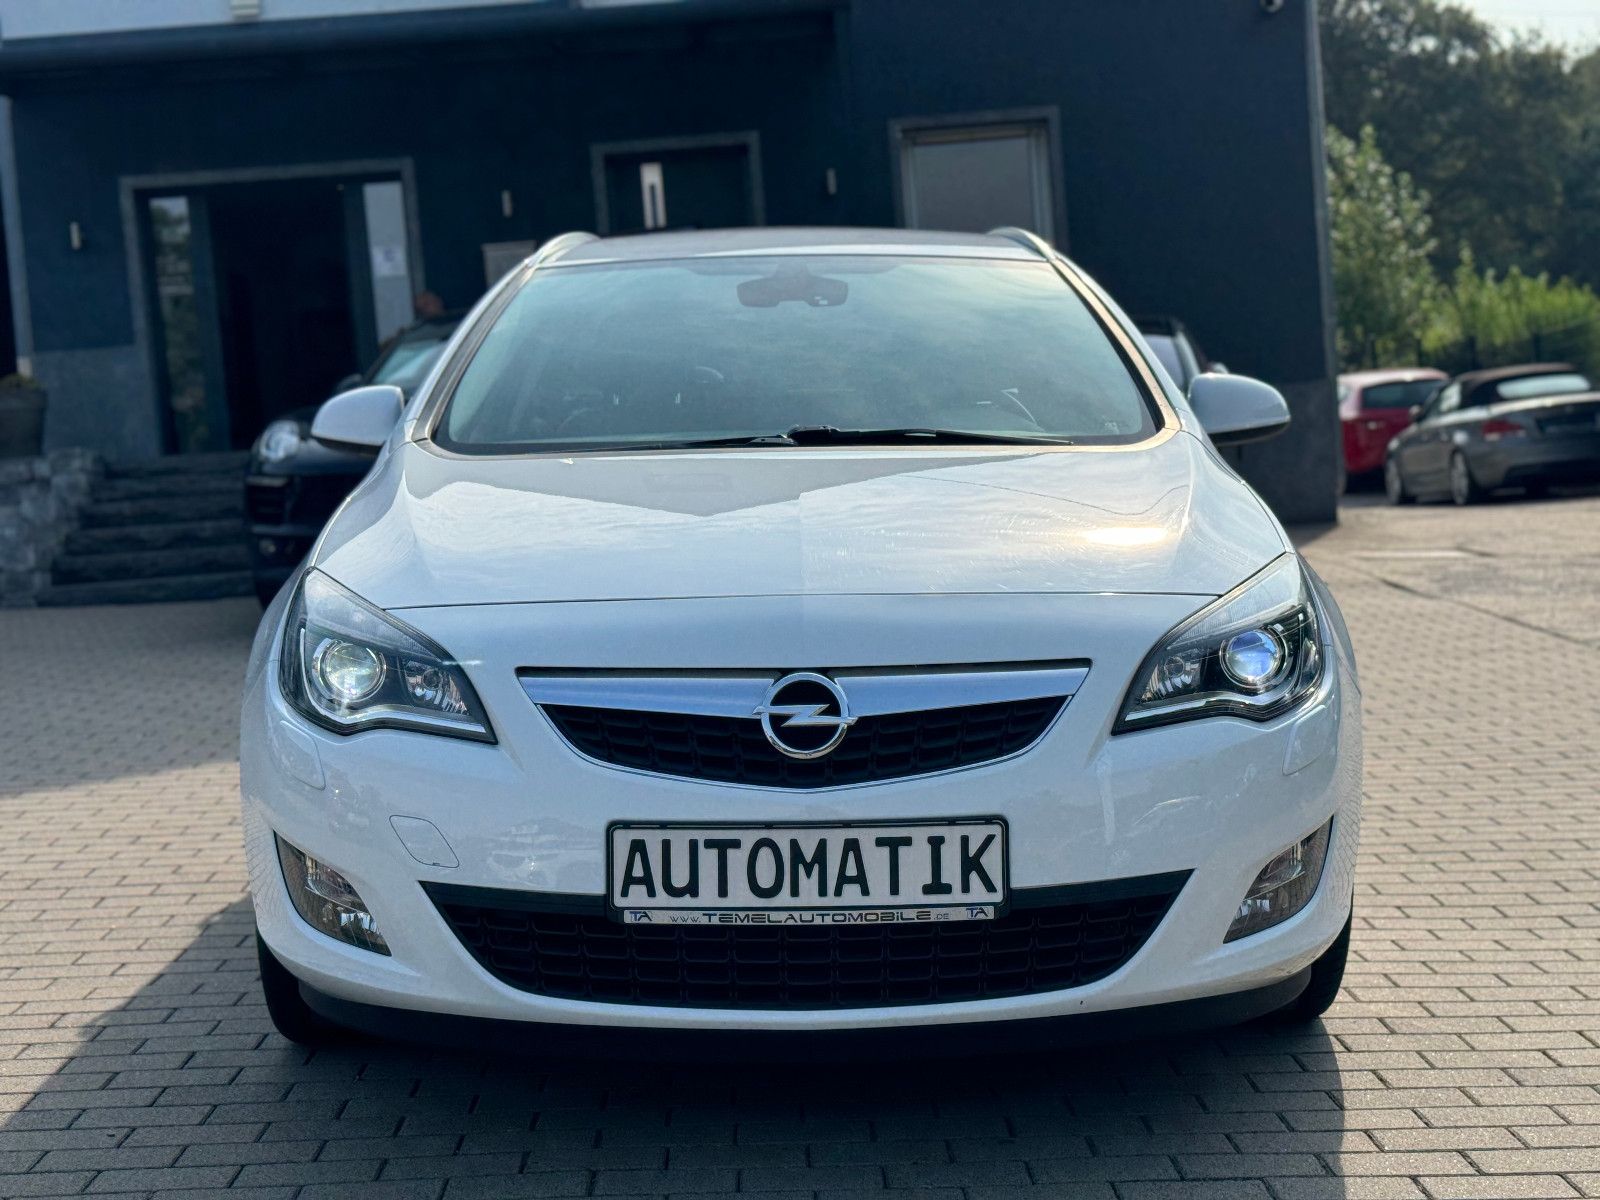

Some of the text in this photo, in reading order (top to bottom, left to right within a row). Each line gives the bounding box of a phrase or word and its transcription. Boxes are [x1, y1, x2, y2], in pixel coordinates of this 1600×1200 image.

[620, 834, 998, 898] AUTOMATIK
[629, 910, 653, 923] TA
[966, 906, 989, 920] TA
